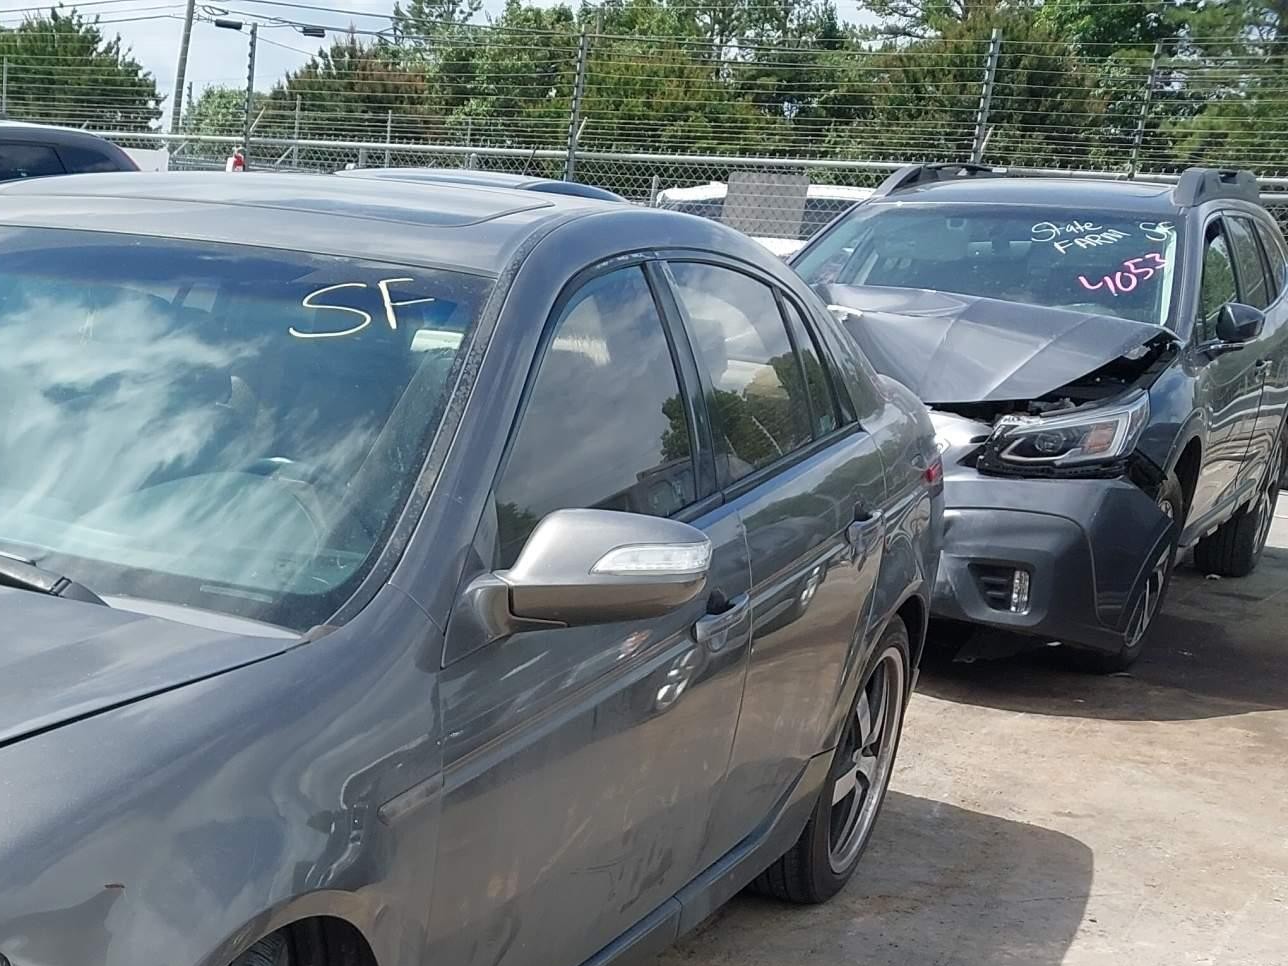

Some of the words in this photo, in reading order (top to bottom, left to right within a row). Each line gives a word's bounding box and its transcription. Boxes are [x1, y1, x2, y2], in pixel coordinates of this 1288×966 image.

[1031, 220, 1103, 242] State
[1054, 229, 1132, 254] FARM
[1078, 253, 1169, 296] 4053
[289, 277, 436, 338] SF
